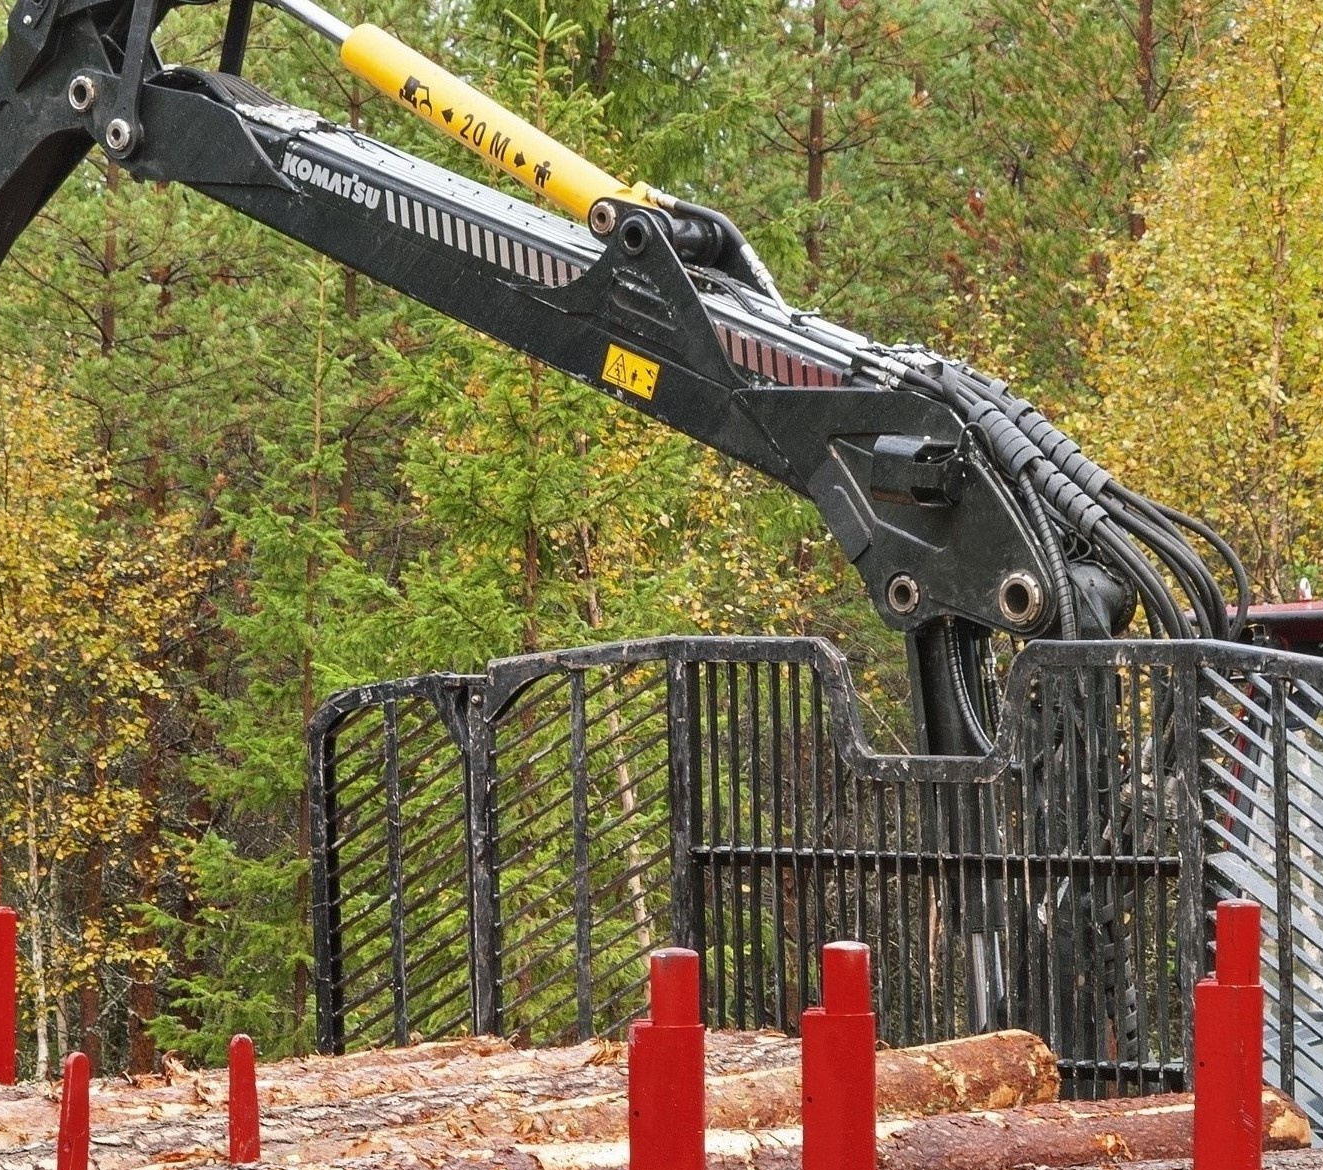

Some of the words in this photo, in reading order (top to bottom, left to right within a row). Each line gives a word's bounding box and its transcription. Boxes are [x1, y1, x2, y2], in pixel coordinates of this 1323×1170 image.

[459, 113, 487, 147] 20
[489, 130, 512, 162] M
[281, 152, 382, 210] KOMATSU
